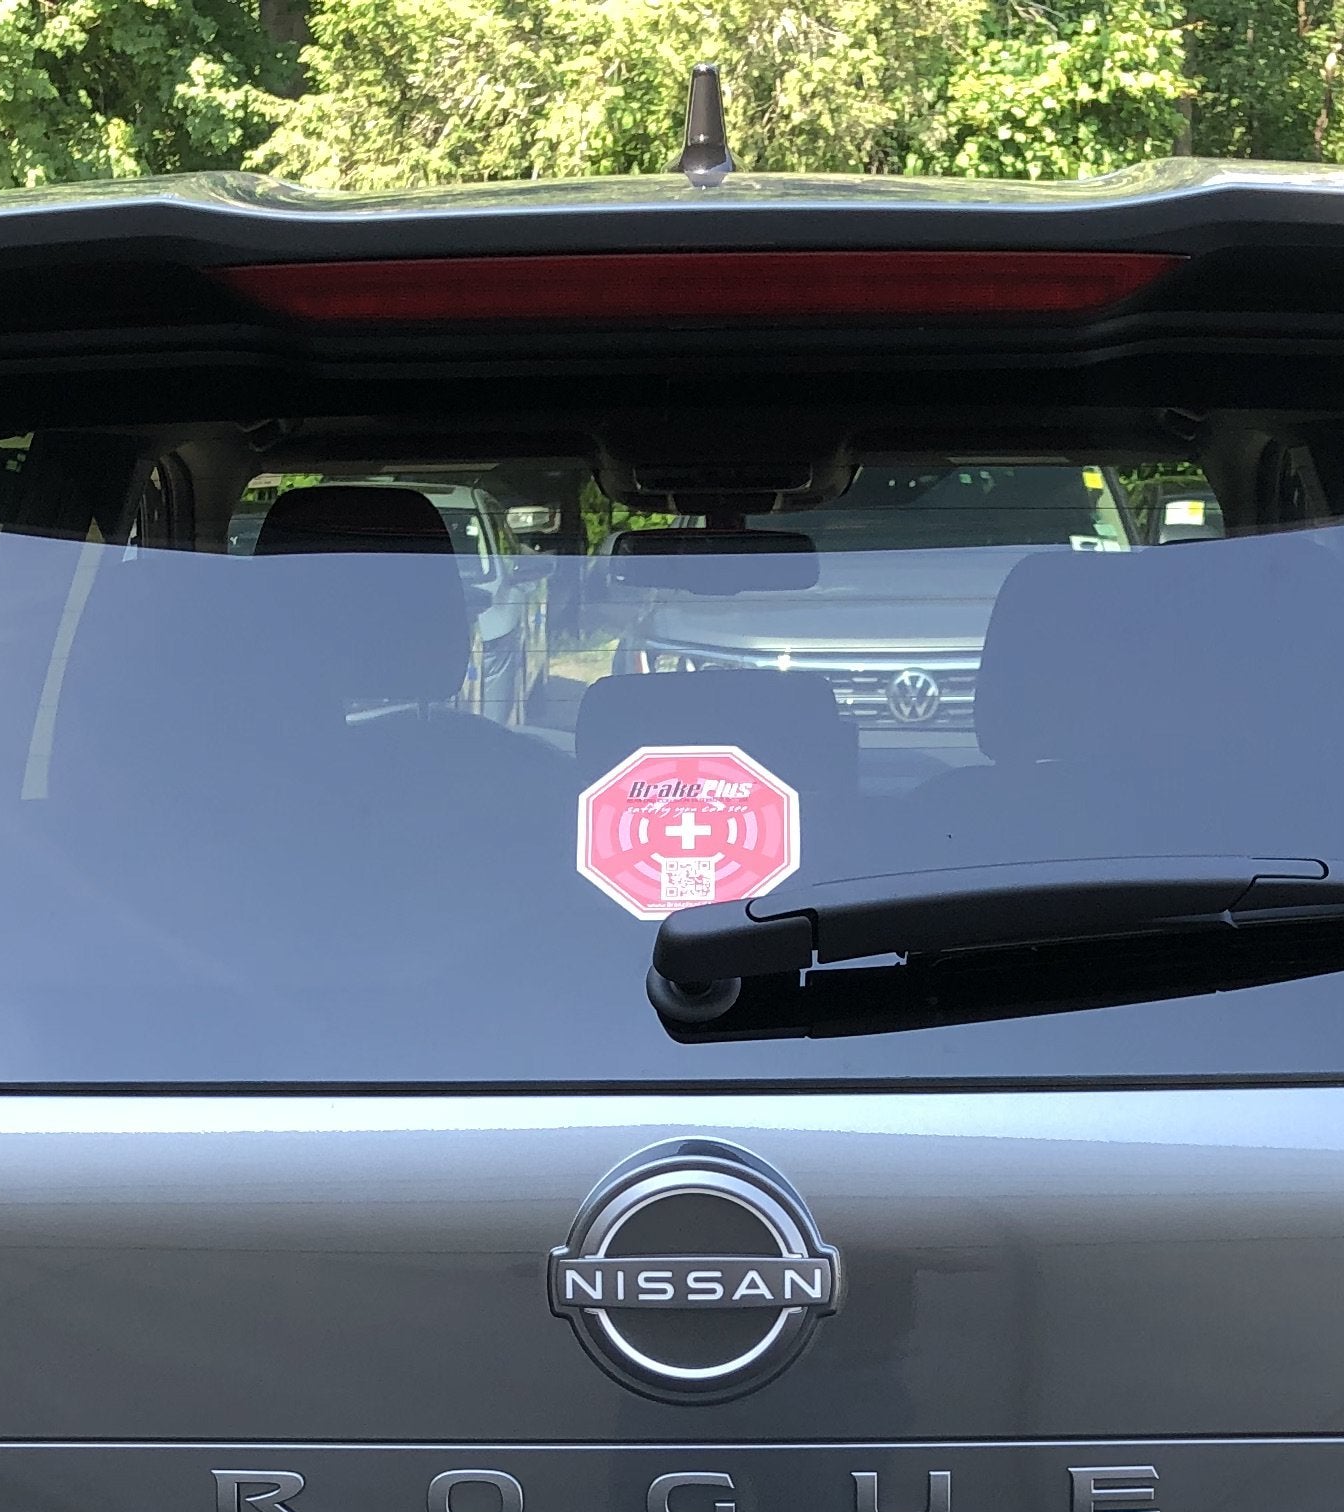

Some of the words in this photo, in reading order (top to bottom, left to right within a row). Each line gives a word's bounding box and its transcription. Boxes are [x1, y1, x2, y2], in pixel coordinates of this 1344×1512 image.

[628, 779, 754, 799] BrakePlus
[673, 807, 698, 818] you
[728, 805, 749, 813] see
[564, 1268, 822, 1301] NISSAN
